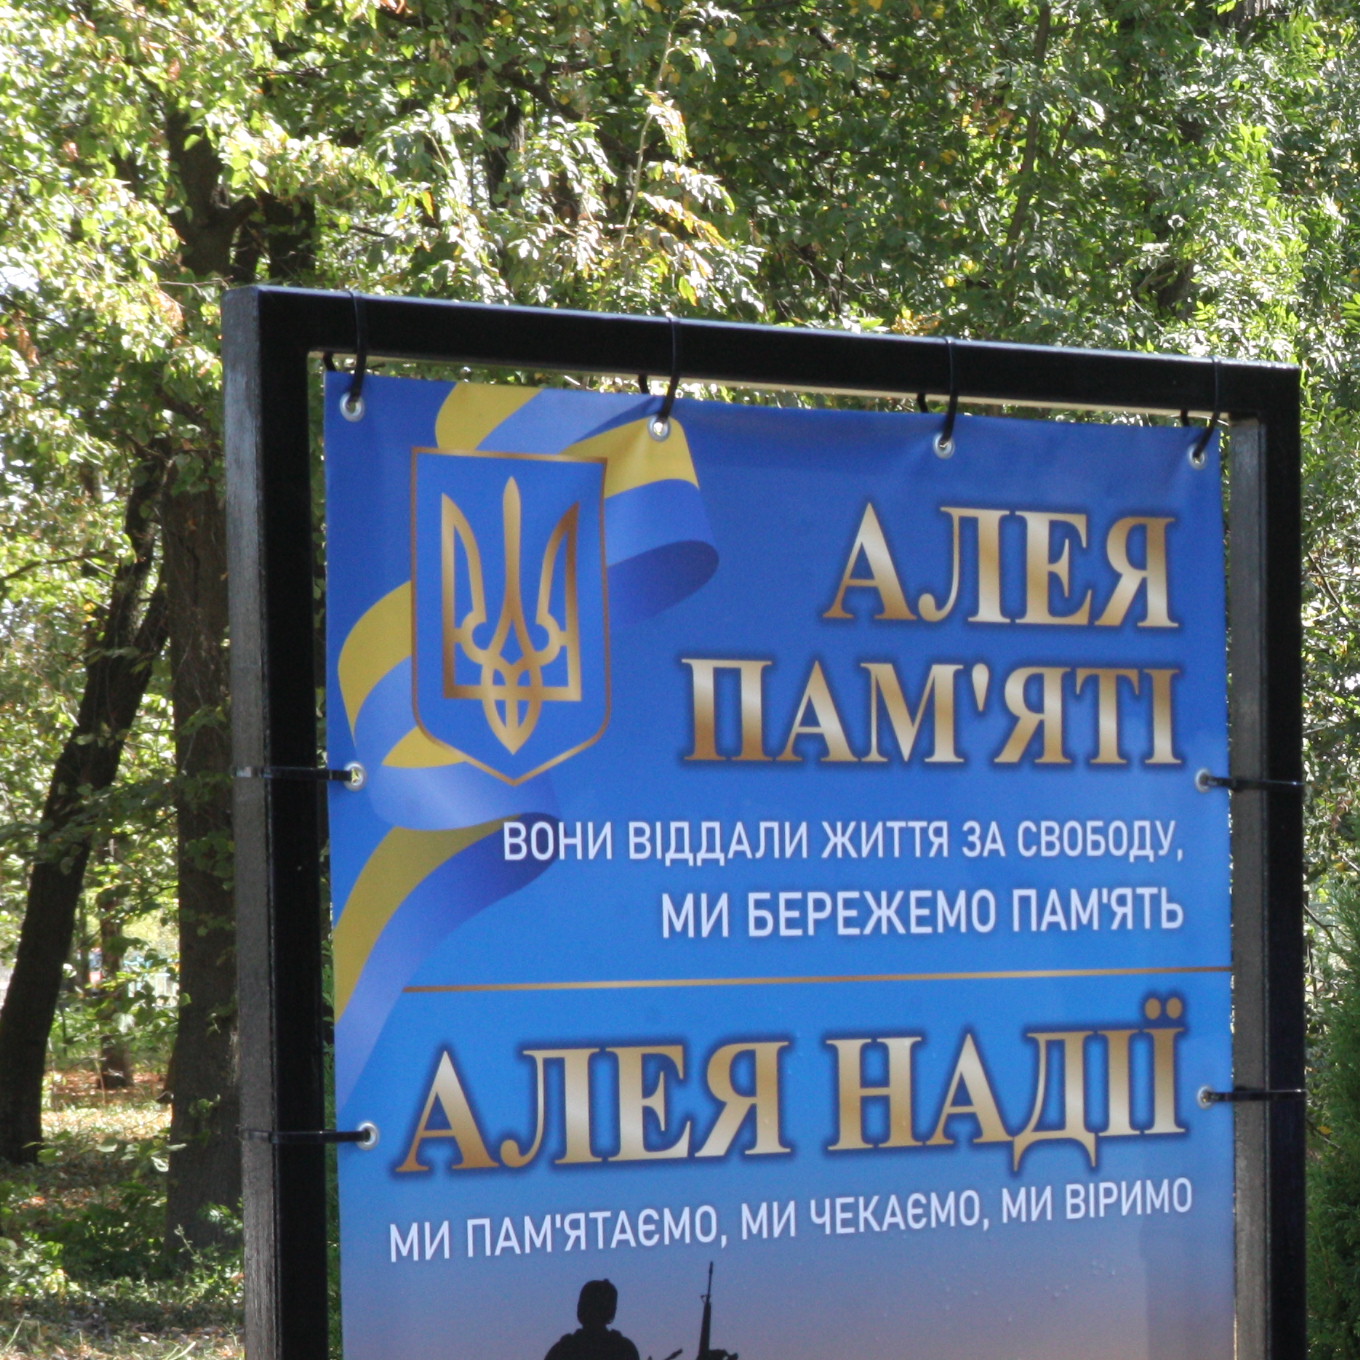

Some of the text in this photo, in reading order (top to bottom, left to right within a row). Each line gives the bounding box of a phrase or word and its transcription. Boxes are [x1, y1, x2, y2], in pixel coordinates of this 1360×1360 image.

[822, 502, 1180, 628] АЛЕЯ
[680, 658, 1183, 766] ПАМ'ЯТІ
[502, 819, 1184, 867] ВОНИ ВІДДАЛИ ЖИТТЯ ЗА СВОБОДУ,
[661, 888, 1184, 938] МИ БЕРЕЖЕМО ПАМ'ЯТЬ
[394, 997, 1186, 1173] АЛЕЯ НАДІЇ
[389, 1178, 1192, 1262] МИ ПАМ'ЯТАЄМО, МИ ЧЕКАЄМО, МИ ВІРИМО
